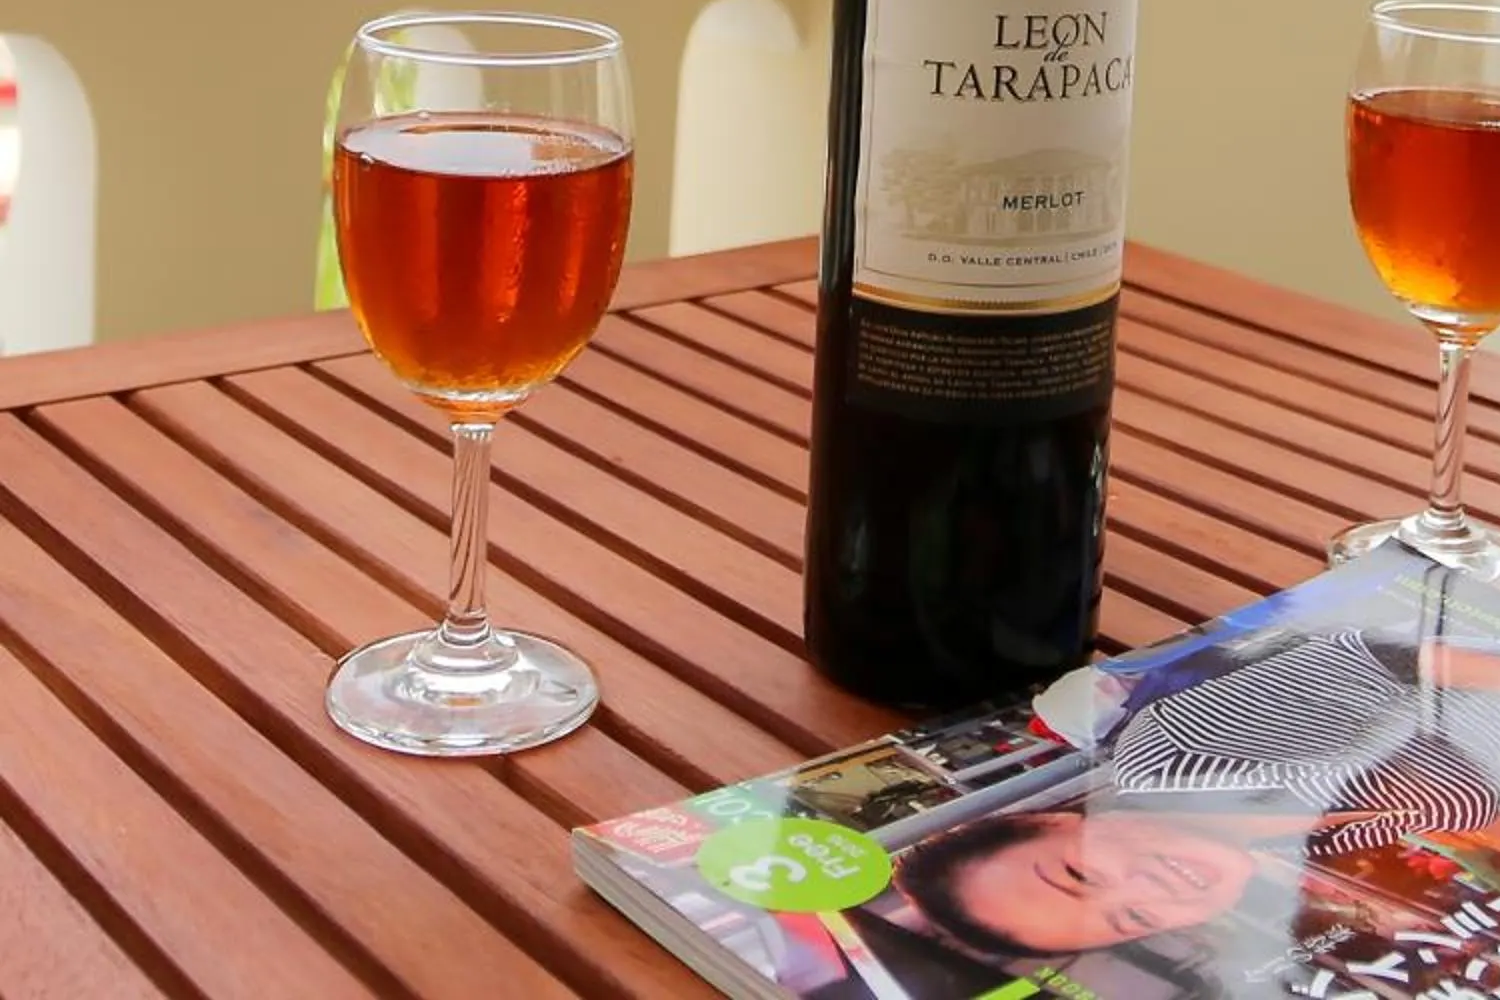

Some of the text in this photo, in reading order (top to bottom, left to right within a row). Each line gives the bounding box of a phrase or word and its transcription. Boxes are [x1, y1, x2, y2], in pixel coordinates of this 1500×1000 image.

[994, 10, 1108, 50] LEON
[1043, 31, 1070, 63] de
[1002, 191, 1086, 211] MERLOT
[960, 256, 1001, 267] VALLE
[1006, 254, 1061, 267] CENTRAL
[788, 832, 862, 881] Free
